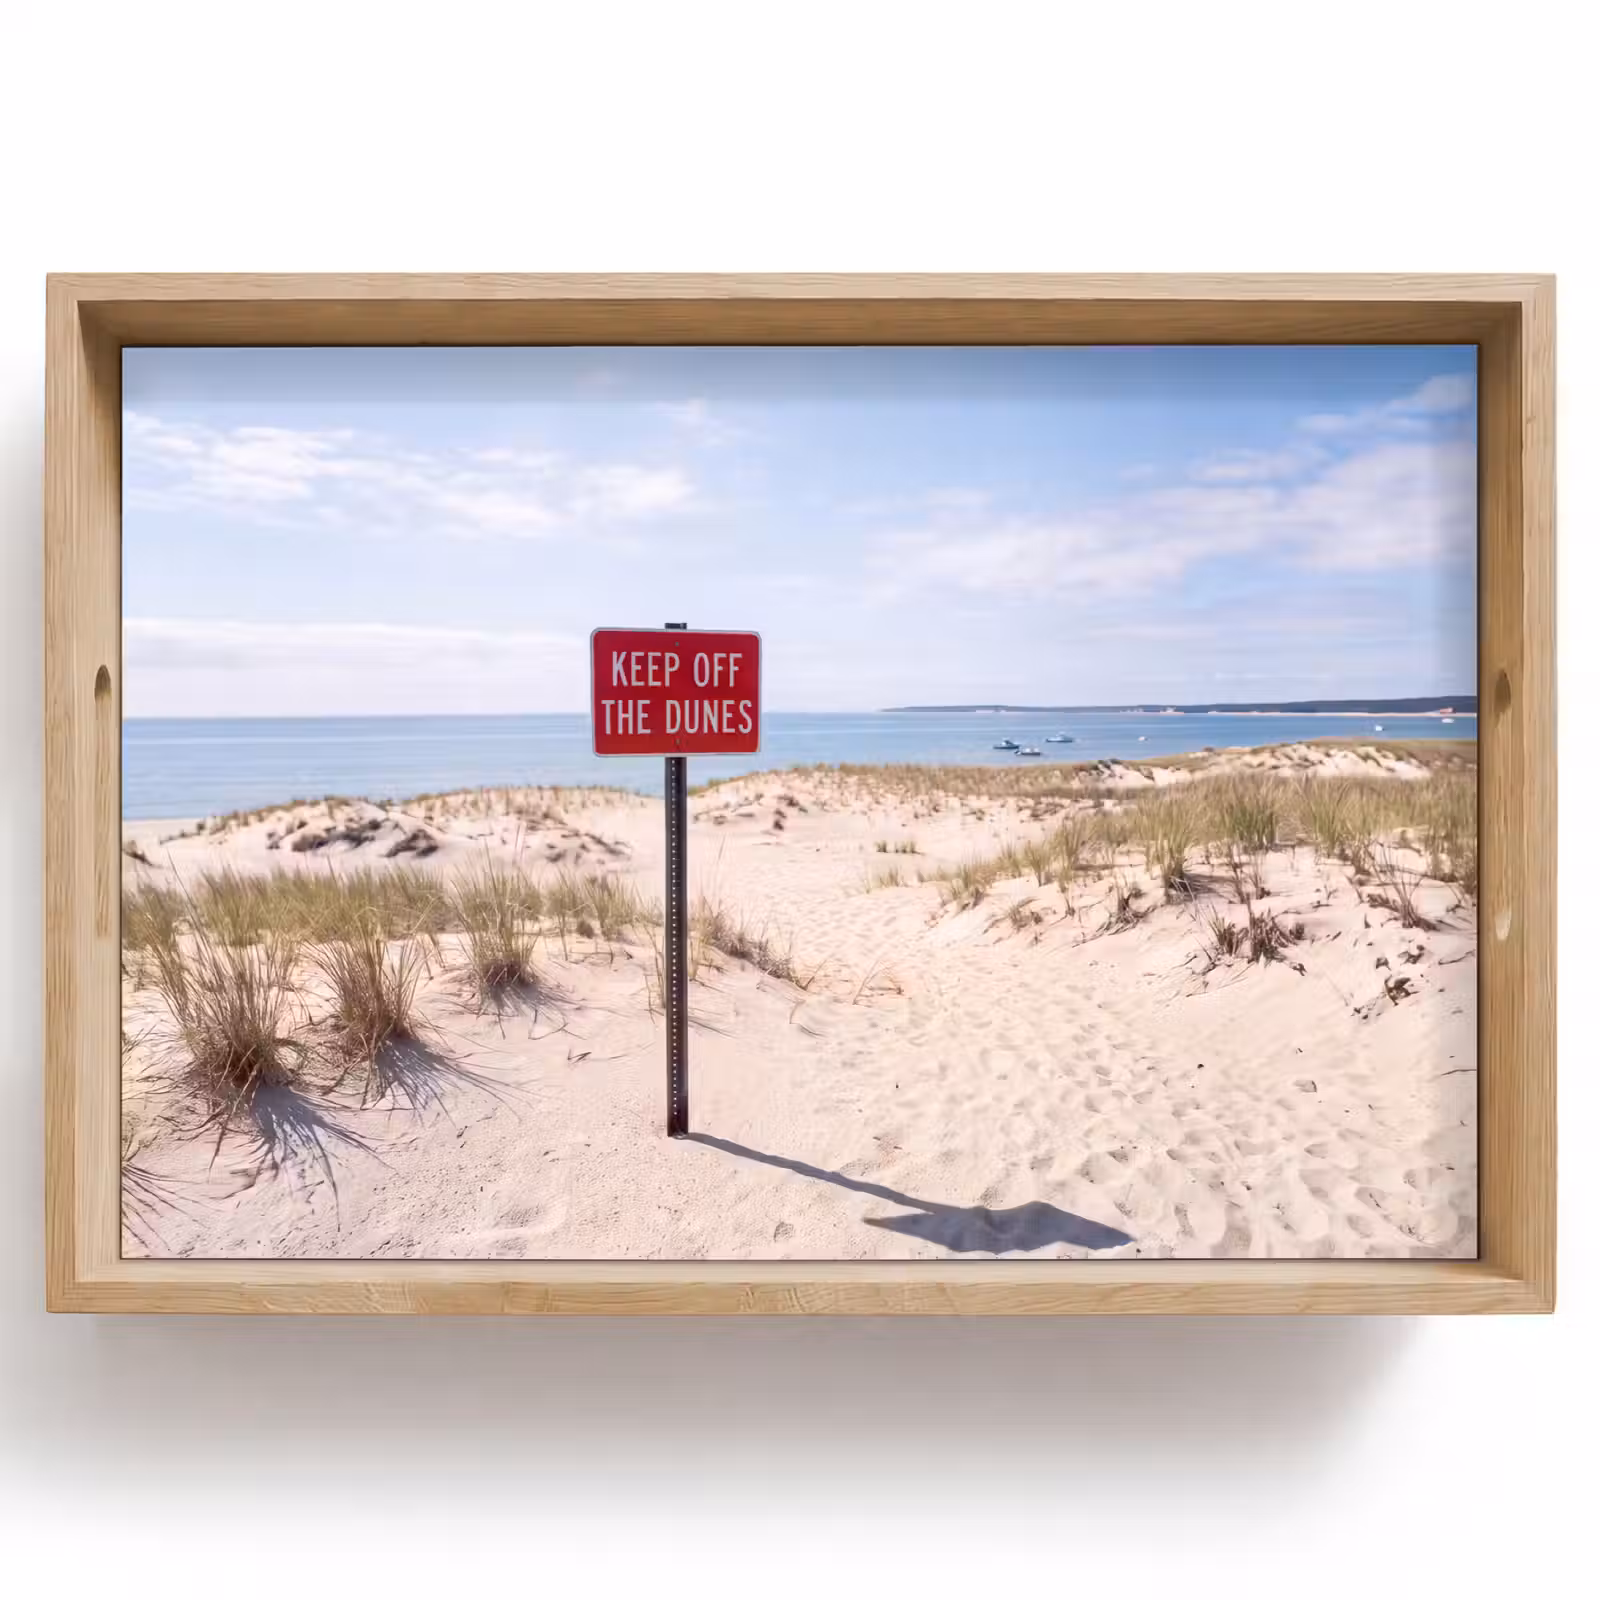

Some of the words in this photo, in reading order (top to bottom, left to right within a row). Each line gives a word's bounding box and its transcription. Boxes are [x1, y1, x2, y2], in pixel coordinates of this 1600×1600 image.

[611, 651, 680, 687] KEEP
[693, 652, 742, 687] OFF
[601, 699, 651, 735] THE
[666, 699, 753, 734] DUNES
